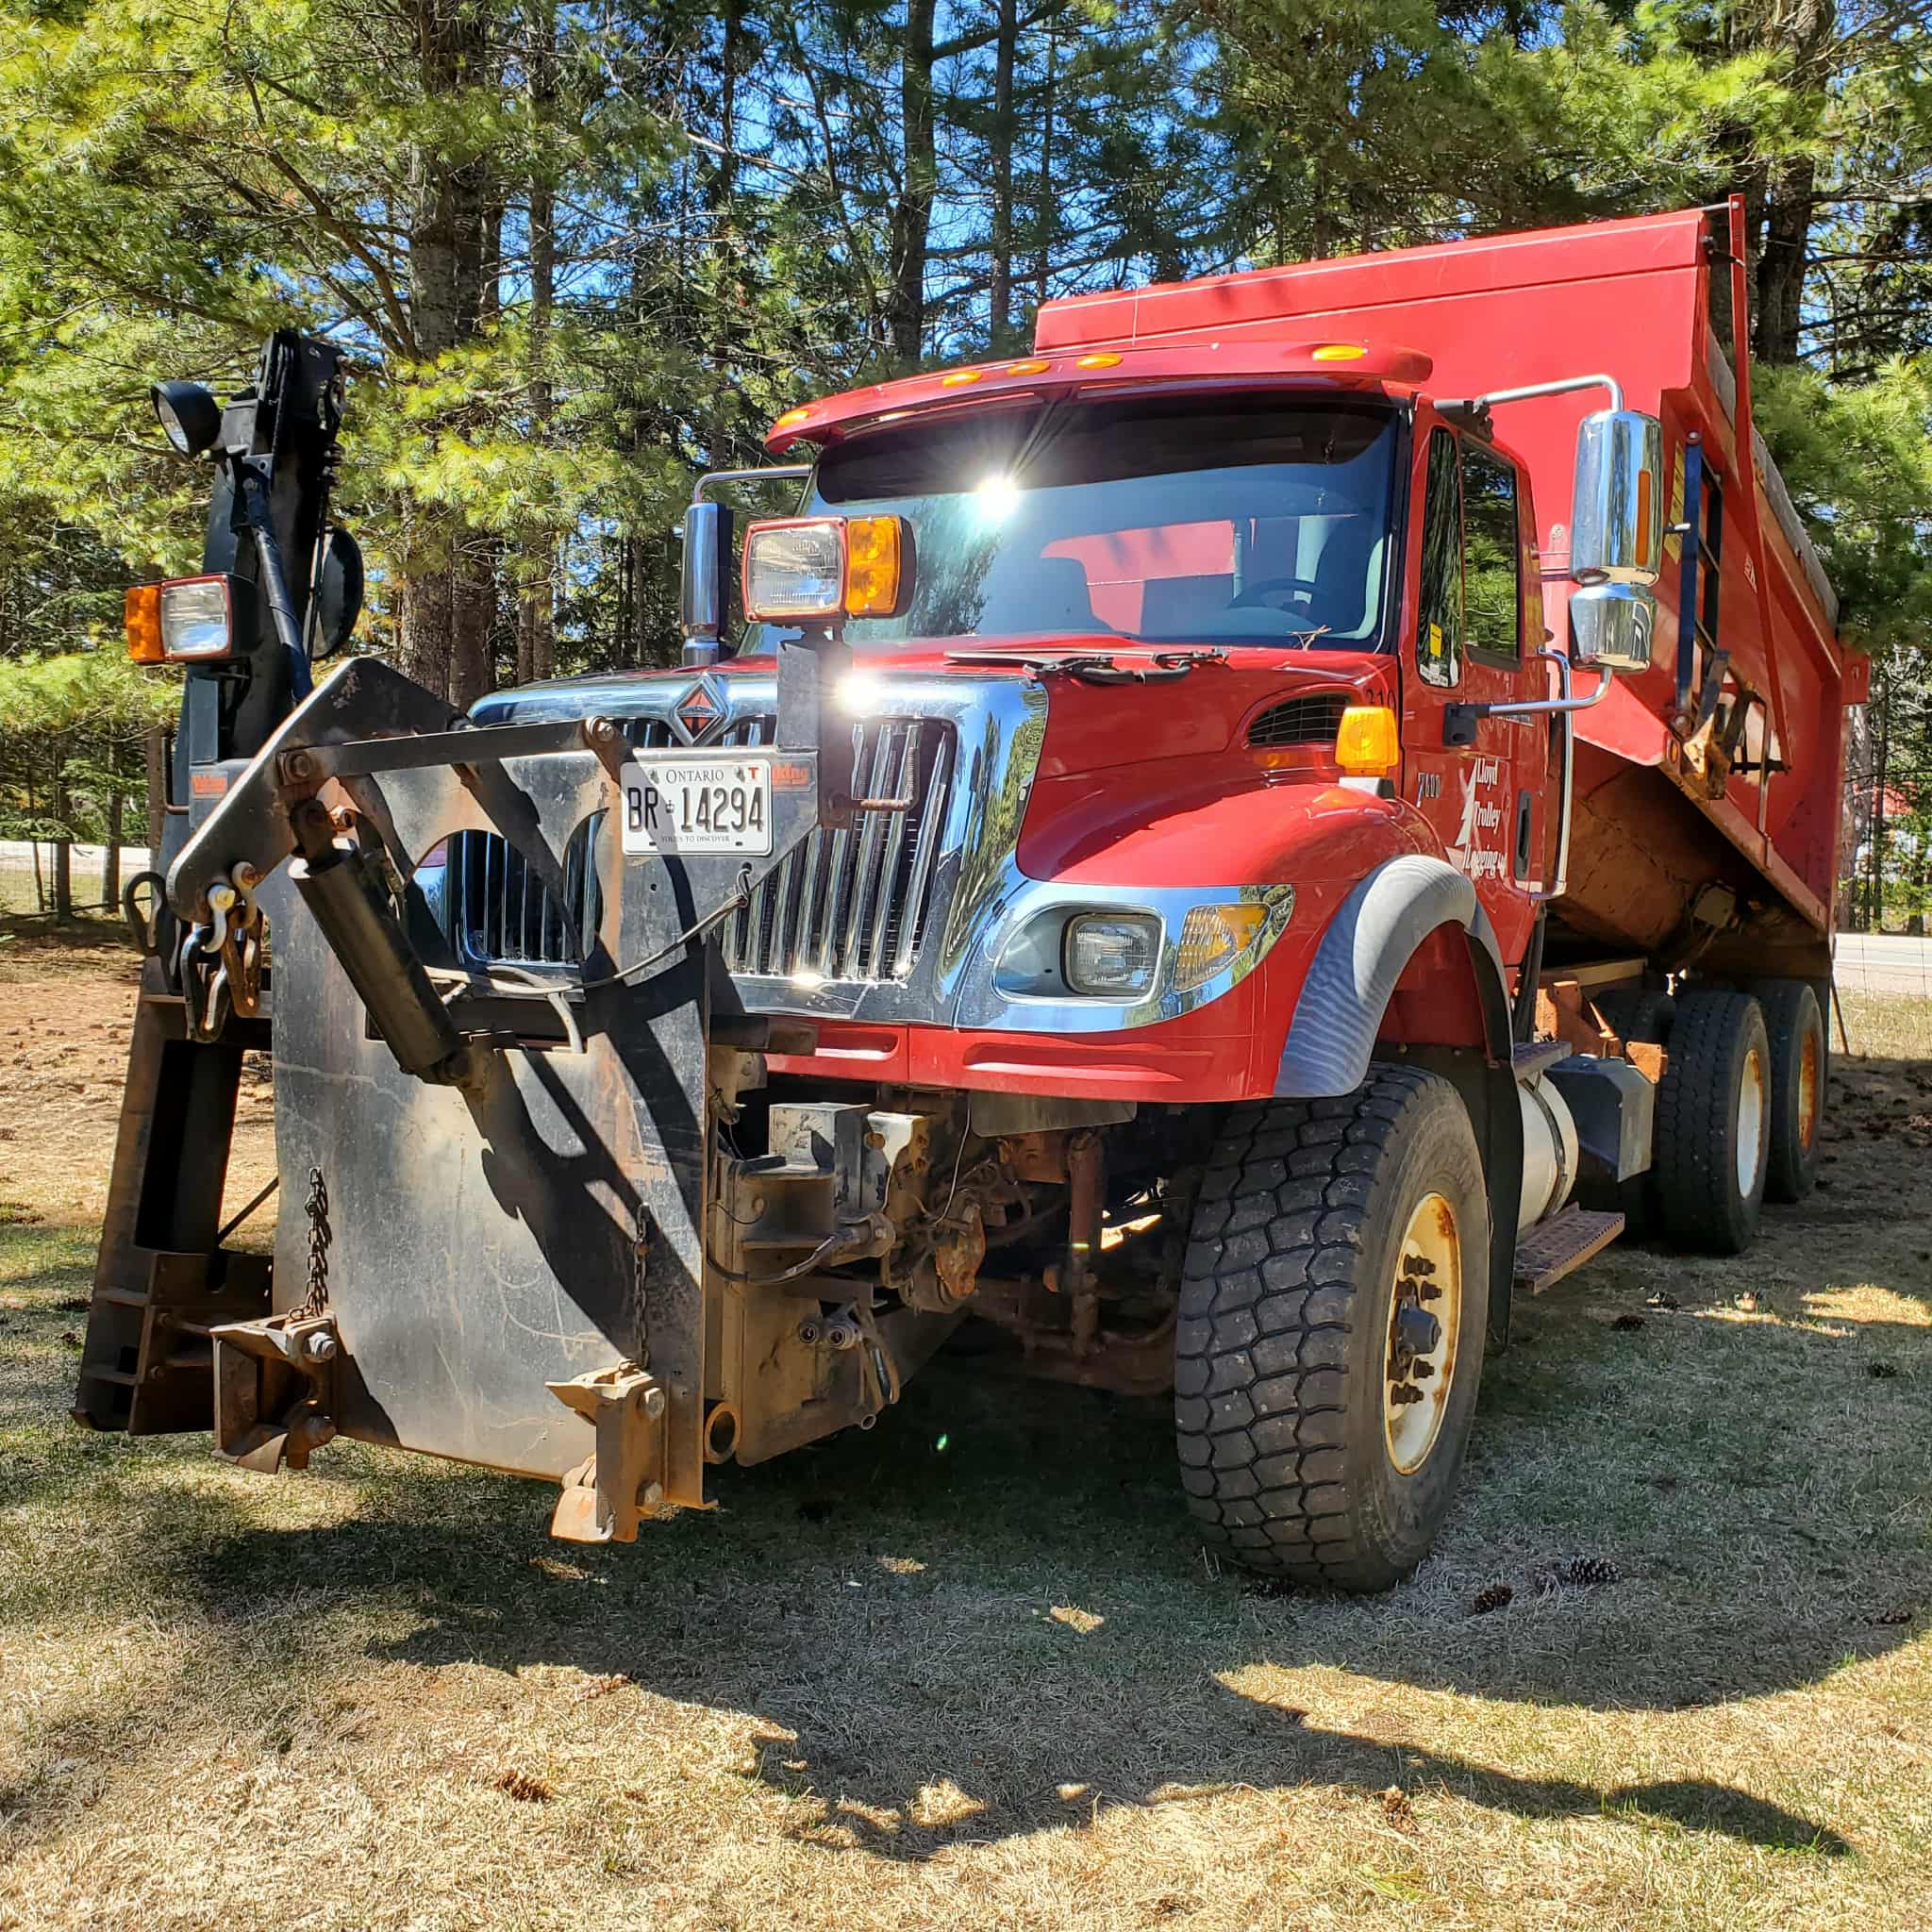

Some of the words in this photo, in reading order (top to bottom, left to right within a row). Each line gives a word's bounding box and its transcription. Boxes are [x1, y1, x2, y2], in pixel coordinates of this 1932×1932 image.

[665, 769, 724, 784] ONTARIO
[748, 767, 758, 779] T
[1475, 758, 1498, 791] Lloyd
[627, 787, 658, 830] BR
[681, 787, 763, 832] 14294
[1474, 800, 1501, 834] Trolley
[1463, 844, 1498, 879] Logging
